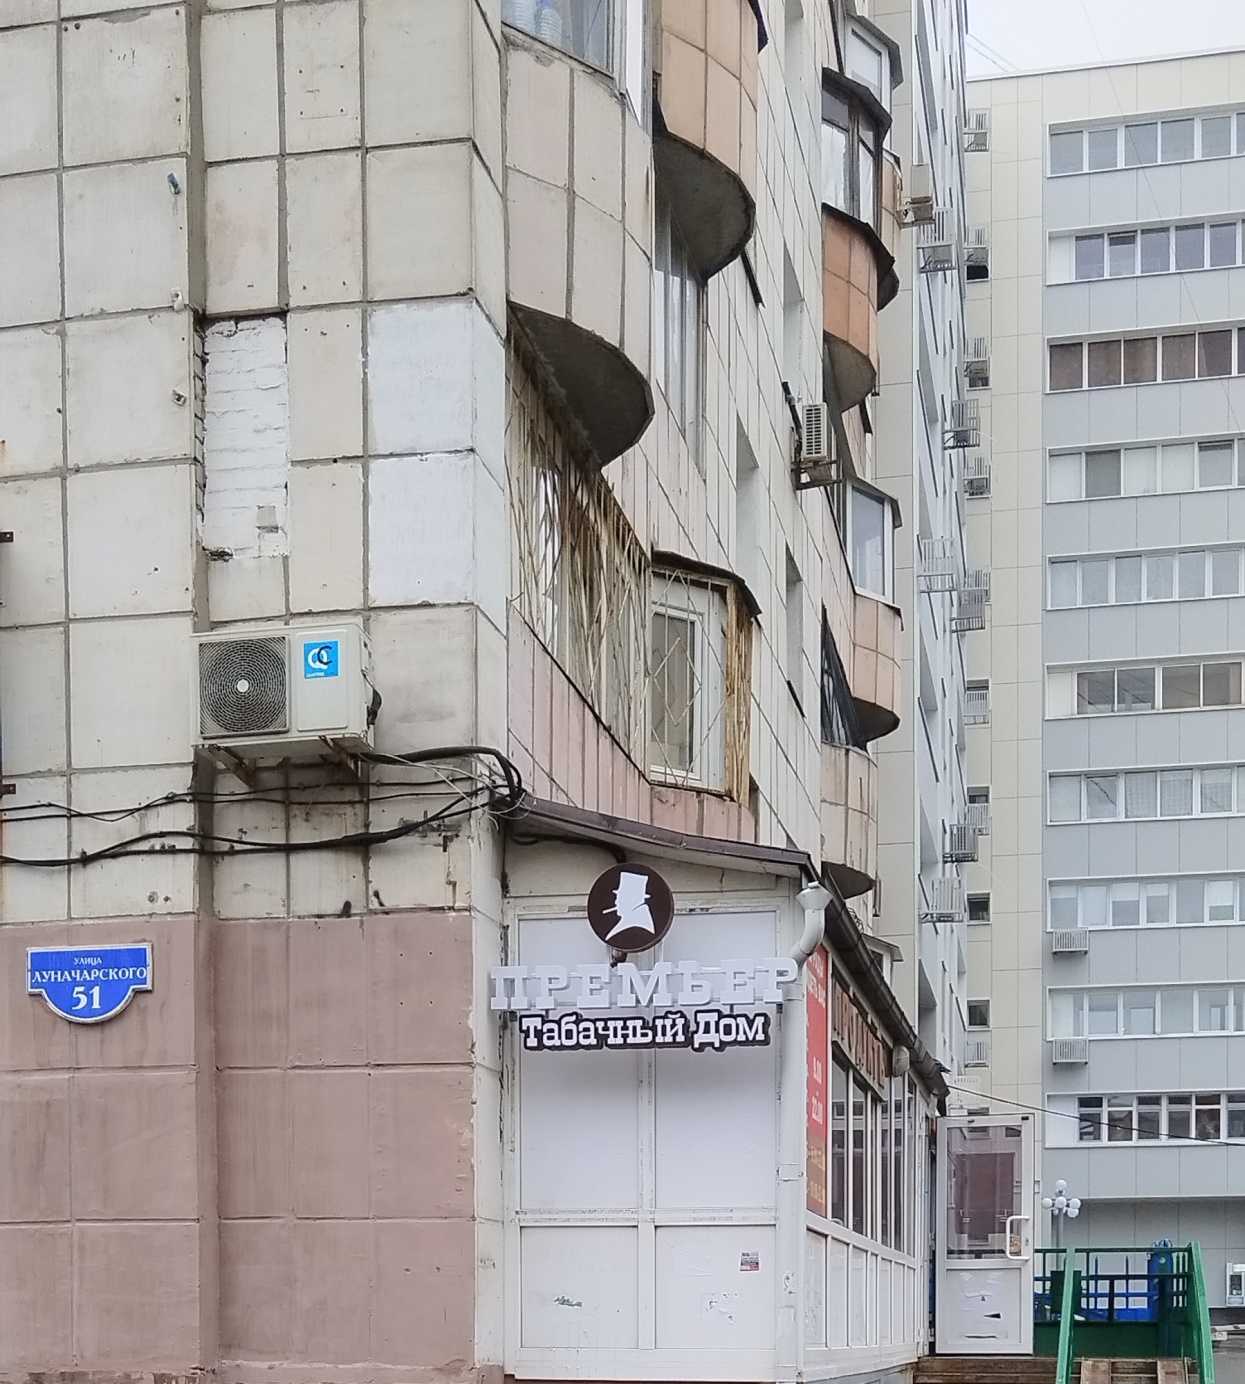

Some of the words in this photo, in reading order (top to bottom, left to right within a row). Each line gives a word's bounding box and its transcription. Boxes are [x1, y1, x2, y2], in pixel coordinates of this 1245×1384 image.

[74, 957, 103, 966] УЛИЦА
[32, 967, 147, 983] ЛУНАЧАРСКОГО
[491, 957, 798, 1010] ПРЕМЬЕР
[72, 986, 101, 1010] 51
[521, 1012, 686, 1047] Табачный
[693, 1011, 767, 1049] Дом
